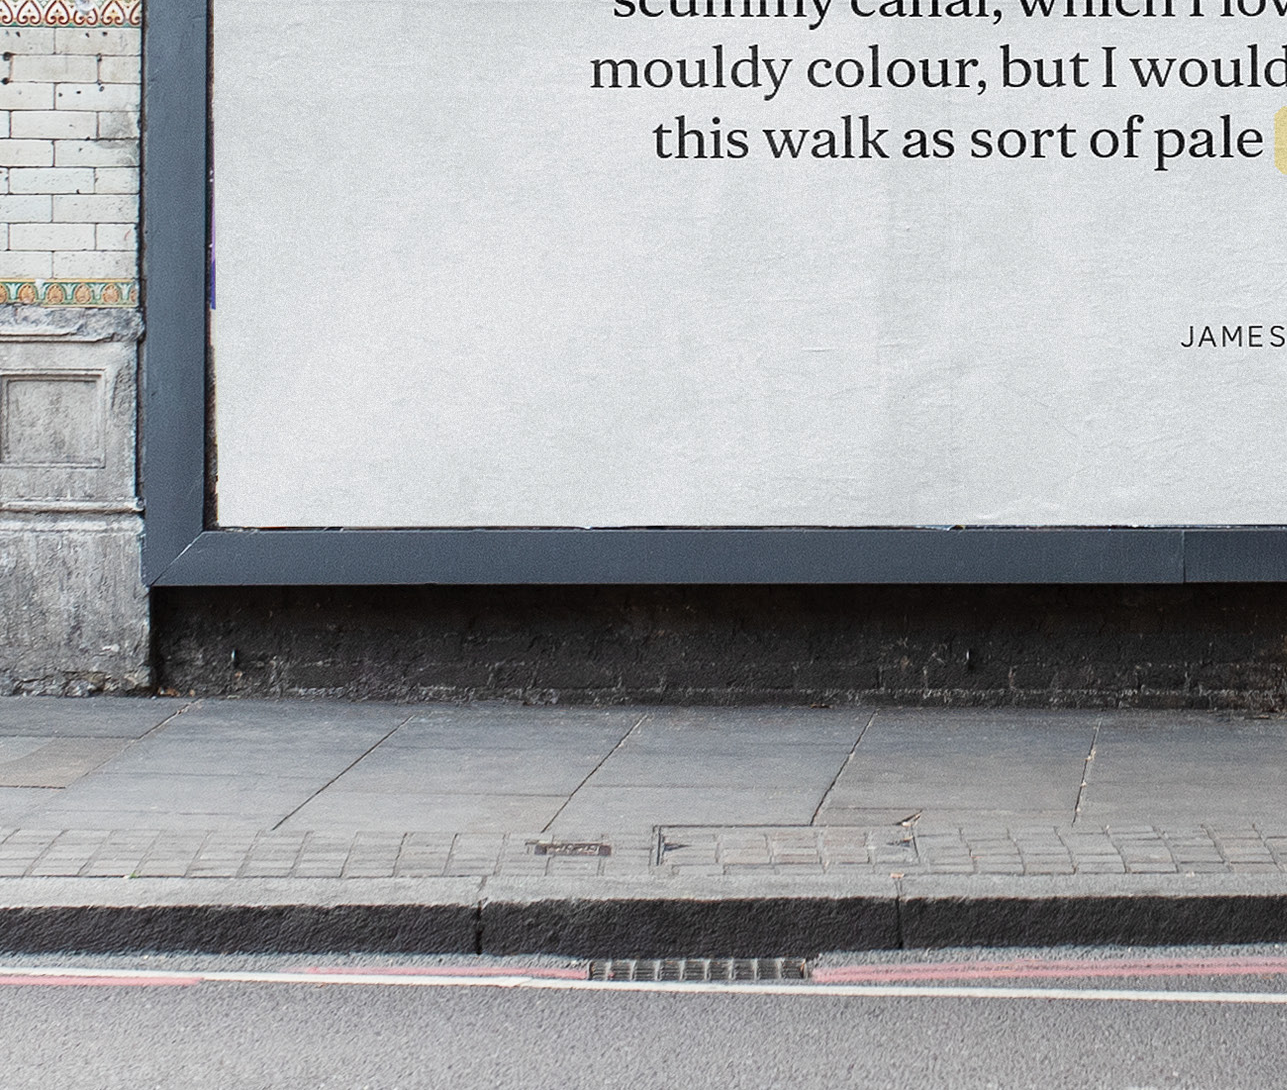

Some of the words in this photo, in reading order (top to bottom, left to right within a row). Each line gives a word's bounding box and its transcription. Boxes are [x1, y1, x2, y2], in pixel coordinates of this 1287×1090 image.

[592, 46, 793, 101] mouldy
[809, 46, 987, 96] colour,
[1001, 46, 1090, 88] but
[1103, 48, 1117, 88] I
[654, 117, 749, 159] this
[764, 116, 890, 159] walk
[904, 131, 955, 159] as
[973, 125, 1077, 159] sort
[1092, 116, 1144, 158] of
[1156, 116, 1263, 172] pale
[1183, 327, 1286, 348] JAMES
